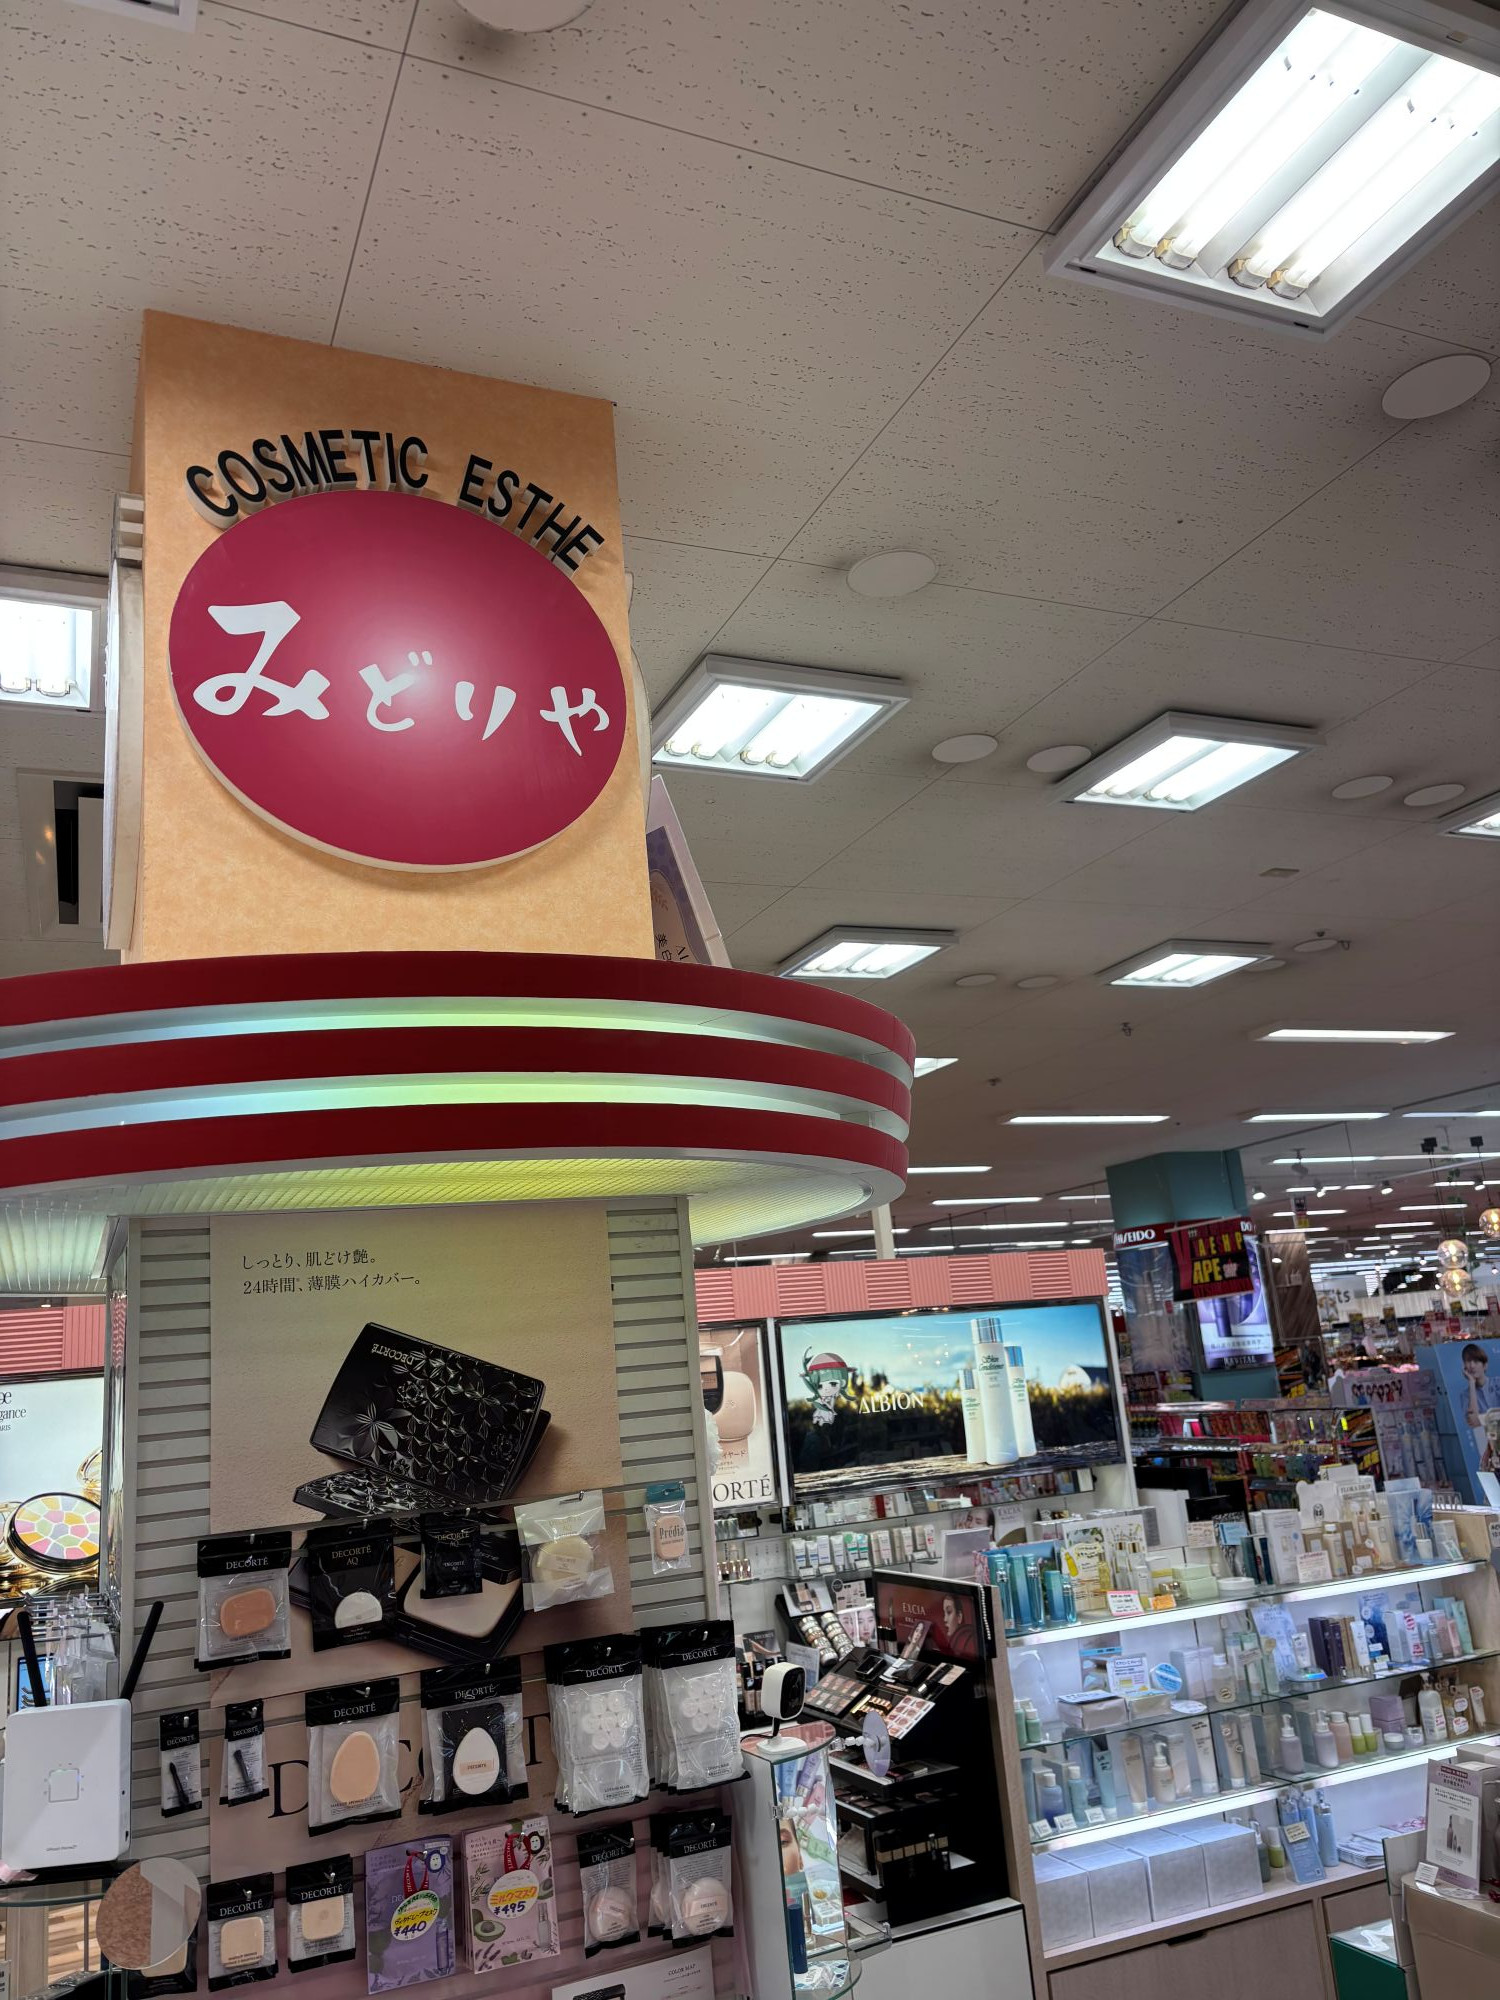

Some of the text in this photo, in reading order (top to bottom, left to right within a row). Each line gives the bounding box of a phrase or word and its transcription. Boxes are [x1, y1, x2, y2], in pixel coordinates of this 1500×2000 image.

[186, 429, 605, 572] COSMETIC ESTHE
[193, 600, 610, 756] みどりや
[242, 1248, 377, 1270] しっとり、肌どけ艶。
[858, 1392, 925, 1415] ALBION
[659, 1524, 685, 1540] Prédia
[331, 1545, 372, 1560] DECORTÉ
[225, 1557, 269, 1570] DECORTÉ
[333, 1702, 377, 1718] DECORTÉ
[300, 1884, 344, 1901] DECORTÉ
[490, 1886, 539, 1906] ミルクマスク
[219, 1900, 263, 1917] DECORTÉ
[493, 1901, 526, 1917] ¥495
[394, 1920, 428, 1937] ¥440
